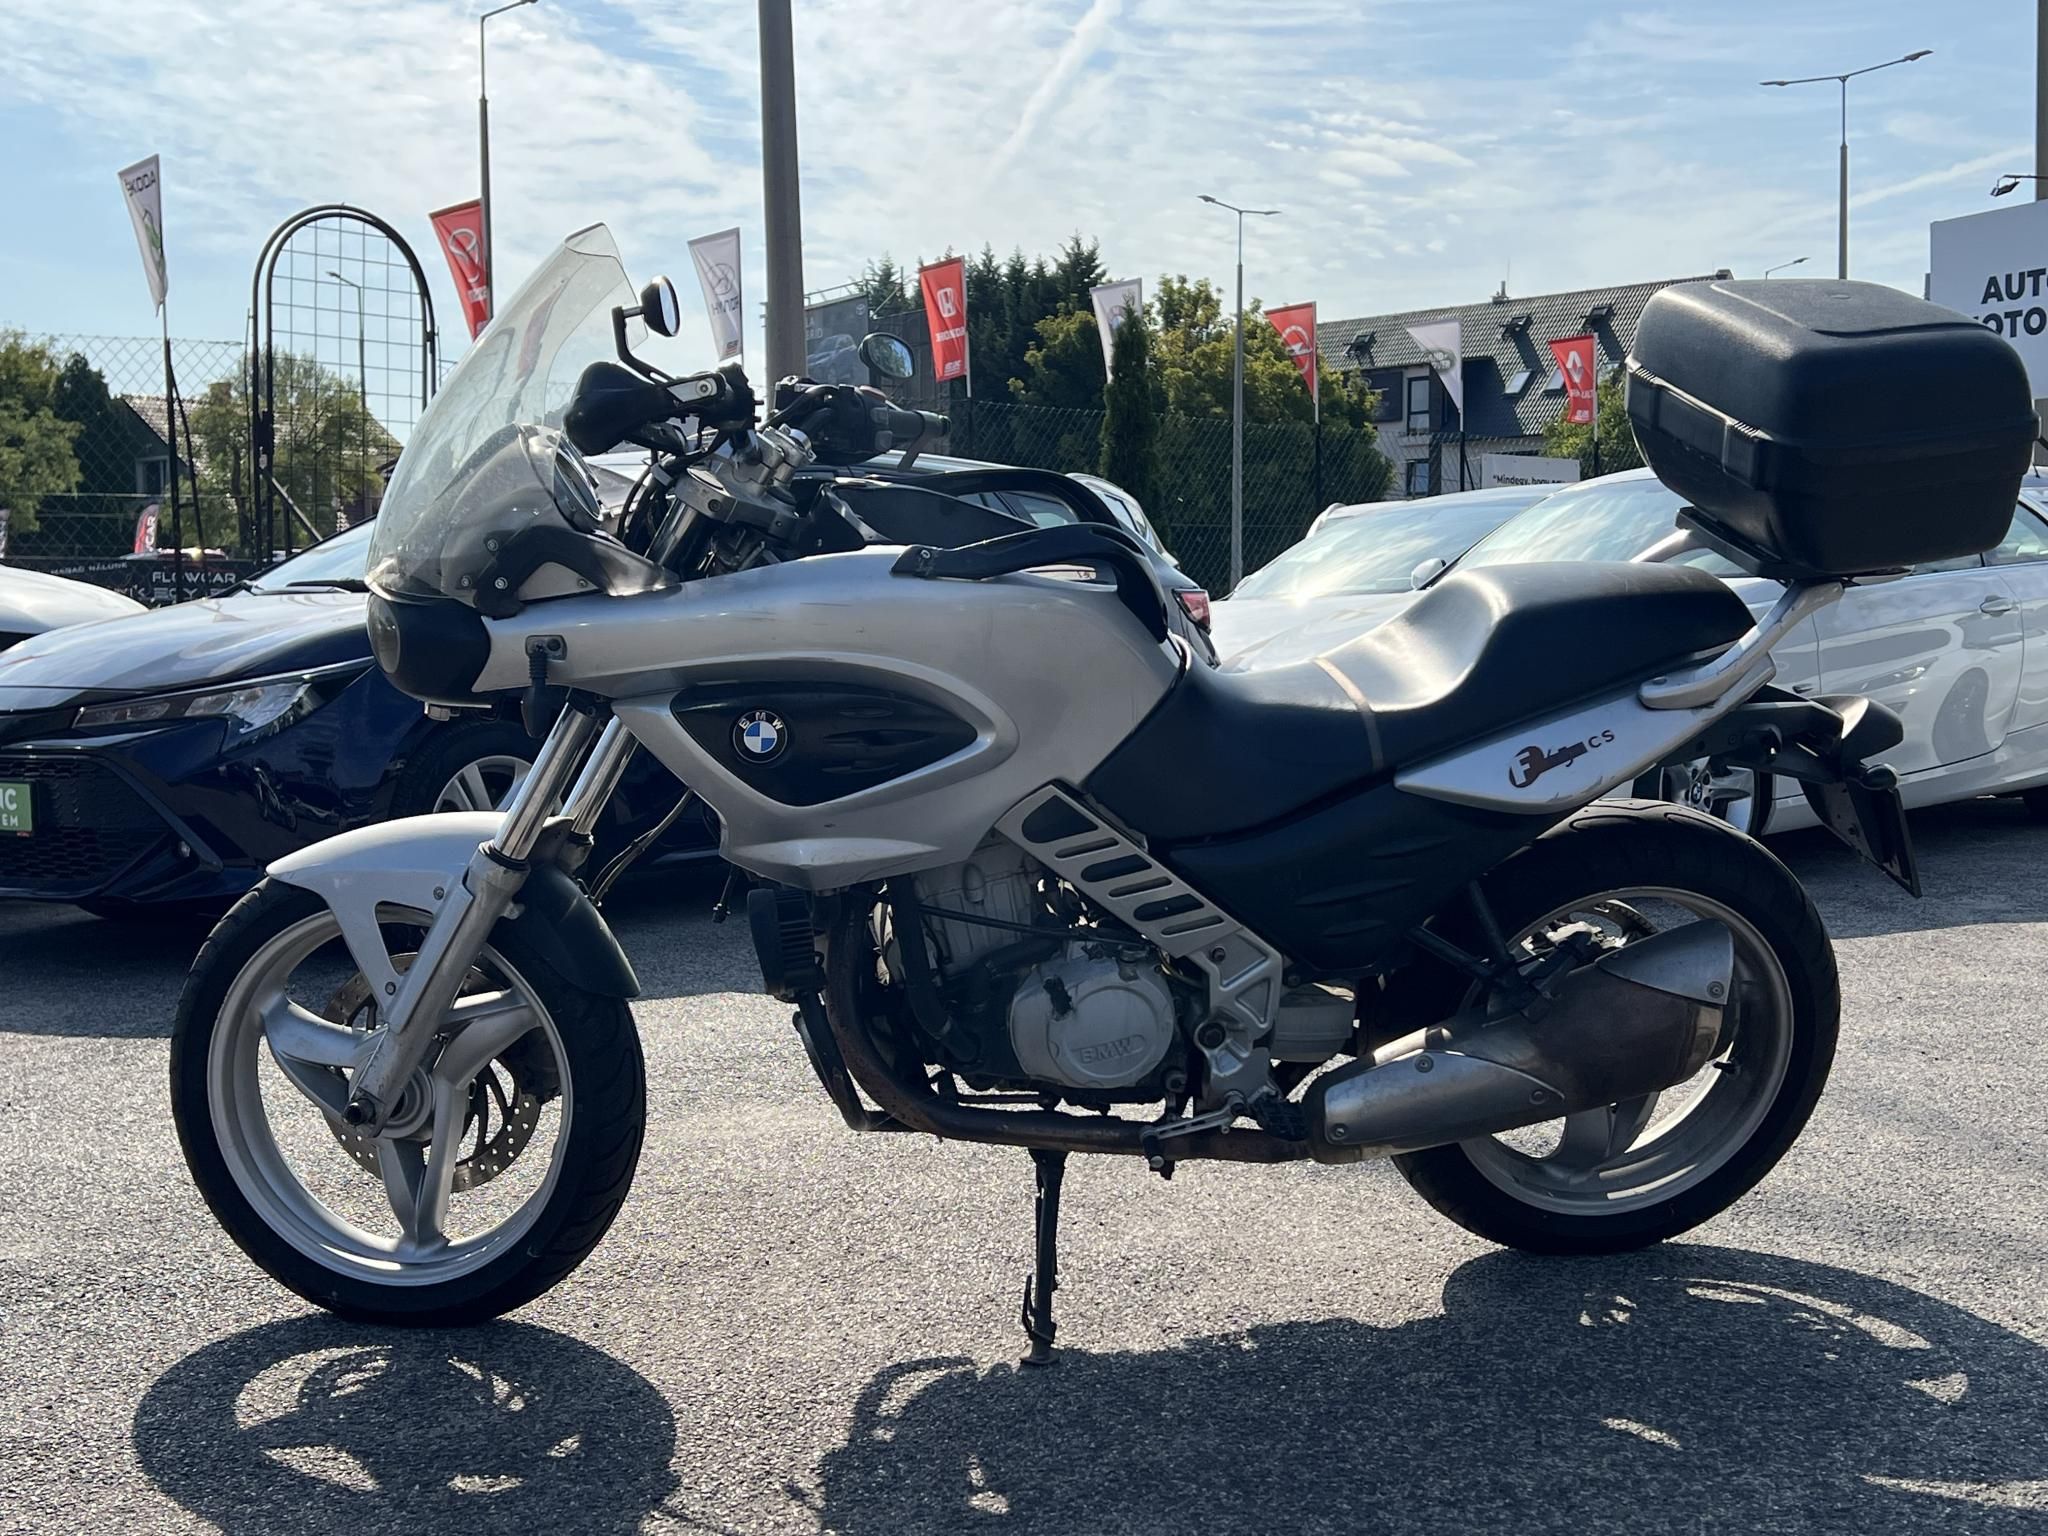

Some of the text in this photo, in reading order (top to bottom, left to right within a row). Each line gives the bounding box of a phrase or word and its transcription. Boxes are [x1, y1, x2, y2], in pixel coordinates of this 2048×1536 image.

[1981, 267, 2048, 305] AUT
[1973, 306, 2048, 338] OTO
[738, 711, 783, 730] BMW
[1588, 729, 1615, 748] CS
[1080, 1037, 1131, 1064] BMW
